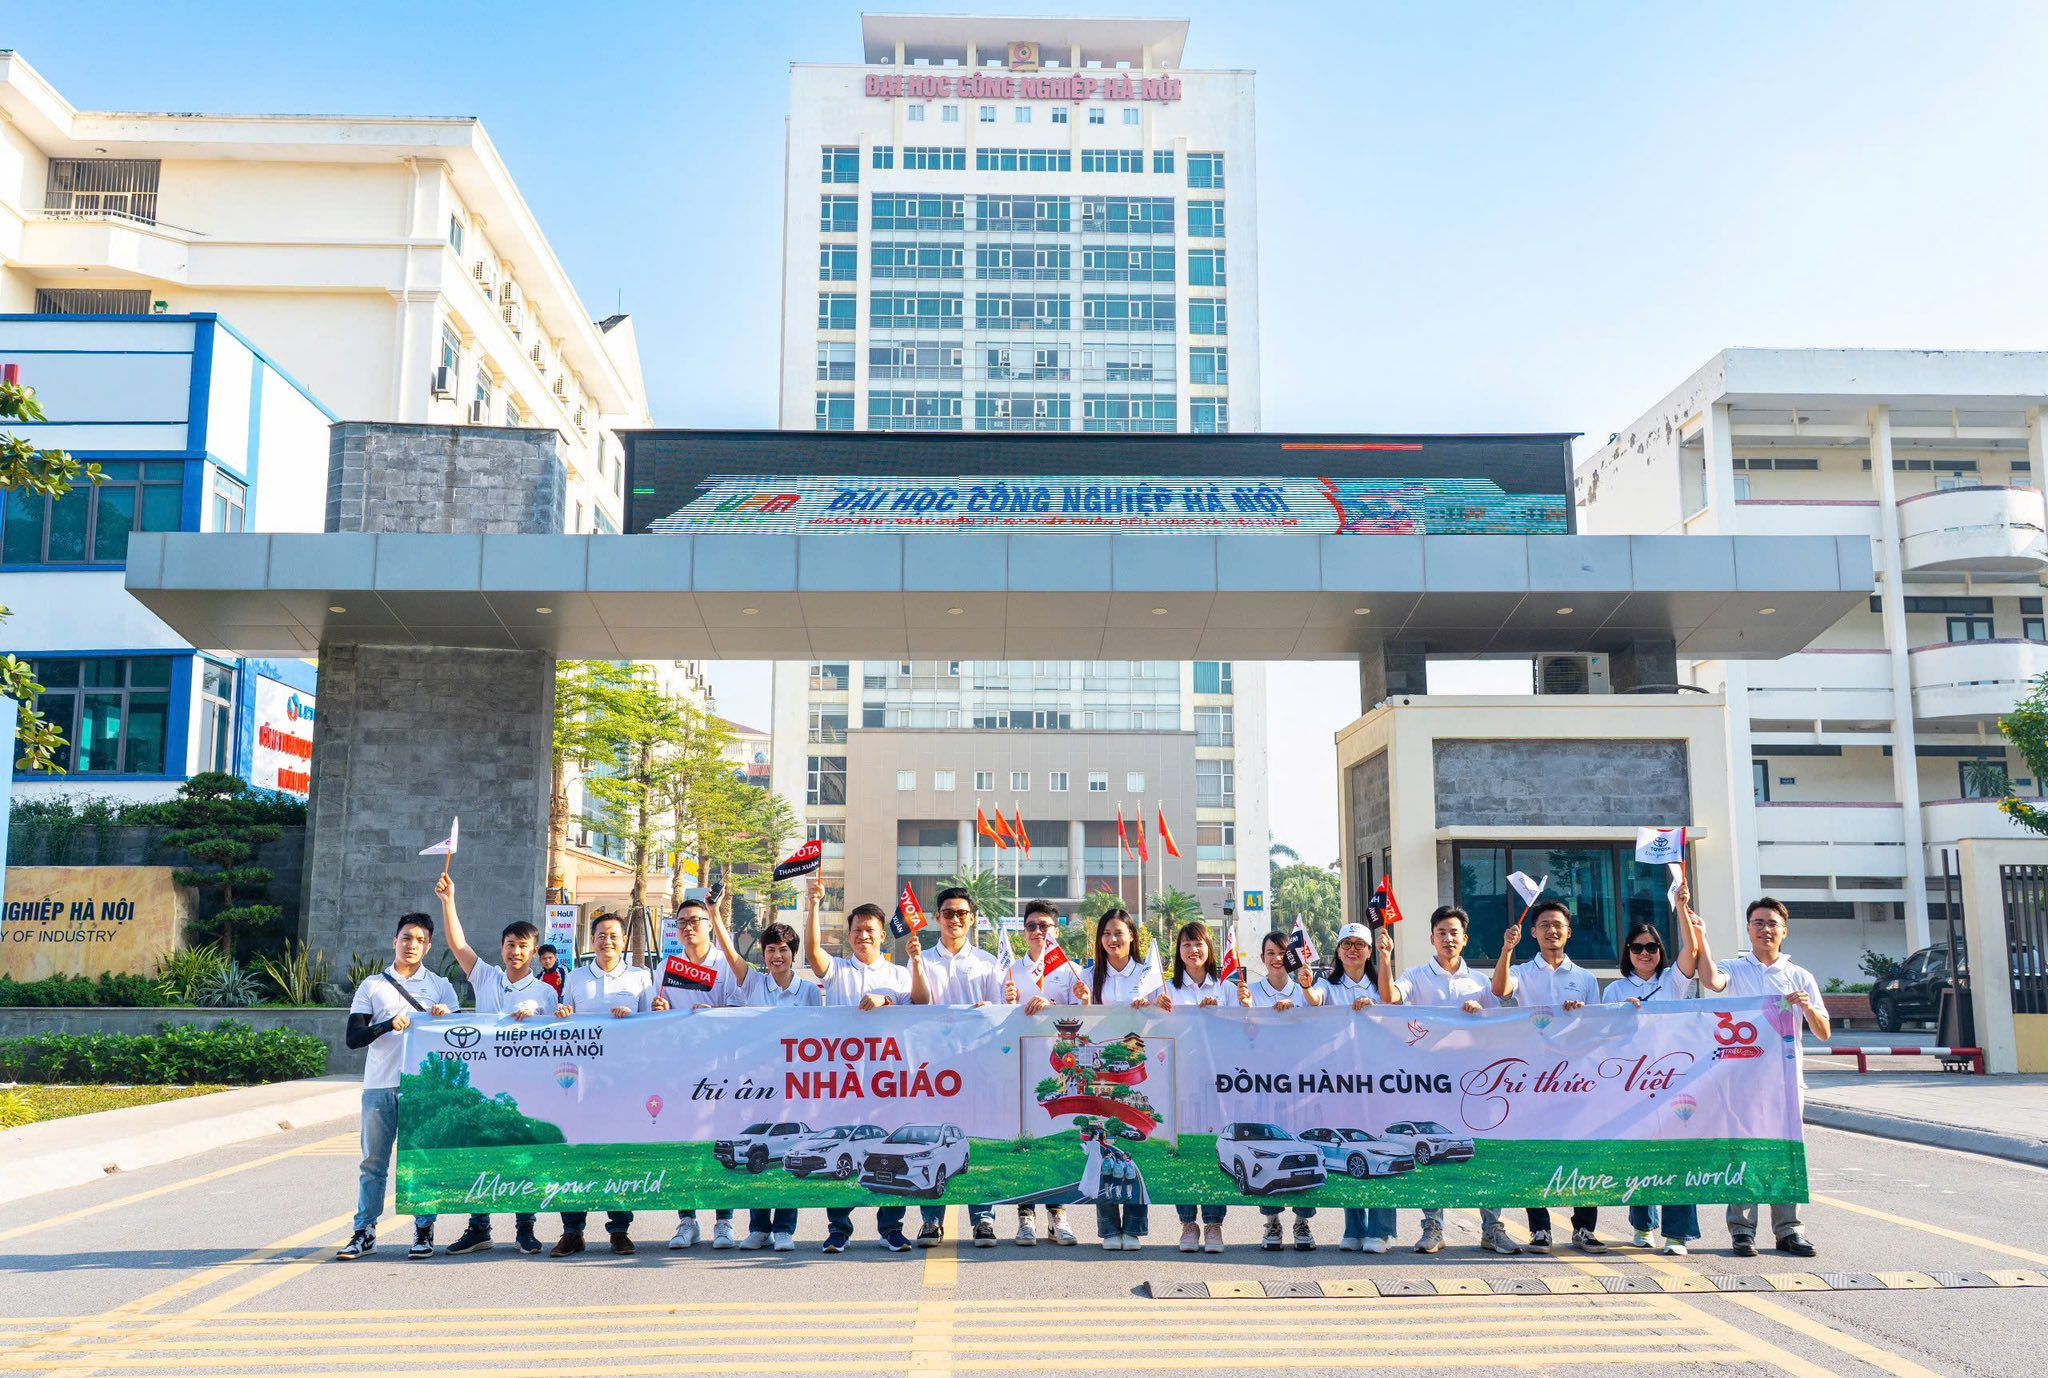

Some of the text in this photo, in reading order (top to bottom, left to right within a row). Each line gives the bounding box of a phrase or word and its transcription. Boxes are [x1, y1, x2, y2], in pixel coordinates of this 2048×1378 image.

[865, 71, 1182, 105] ĐẠI HỌC CÔNG NGHIỆP HÀ NỘI
[967, 481, 1051, 512] CÔNG
[1062, 483, 1172, 517] NGHIỆP
[1183, 483, 1227, 512] HÀ
[779, 865, 801, 876] THANH
[70, 898, 95, 920] HÀ
[101, 898, 135, 925] NỘI
[1246, 895, 1263, 907] A.1
[13, 931, 34, 942] OF
[38, 930, 117, 942] INDUSTRY
[670, 960, 712, 982] TOYOTA
[495, 1026, 603, 1046] HIỆP HỘI ĐẠI LÝ
[1713, 1011, 1758, 1046] 30
[438, 1051, 487, 1061] TOYOTA
[494, 1042, 603, 1060] TOYOTA HÀ NỘI
[780, 1037, 902, 1062] TOYOTA
[691, 1077, 778, 1101] tri ân
[785, 1062, 962, 1100] NHÀ GIÁO
[1216, 1067, 1452, 1094] ĐỒNG HÀNH CÙNG
[1459, 1051, 1695, 1131] Tri thức Việt
[464, 1167, 666, 1209] Move your world
[1544, 1162, 1747, 1202] Move your world
